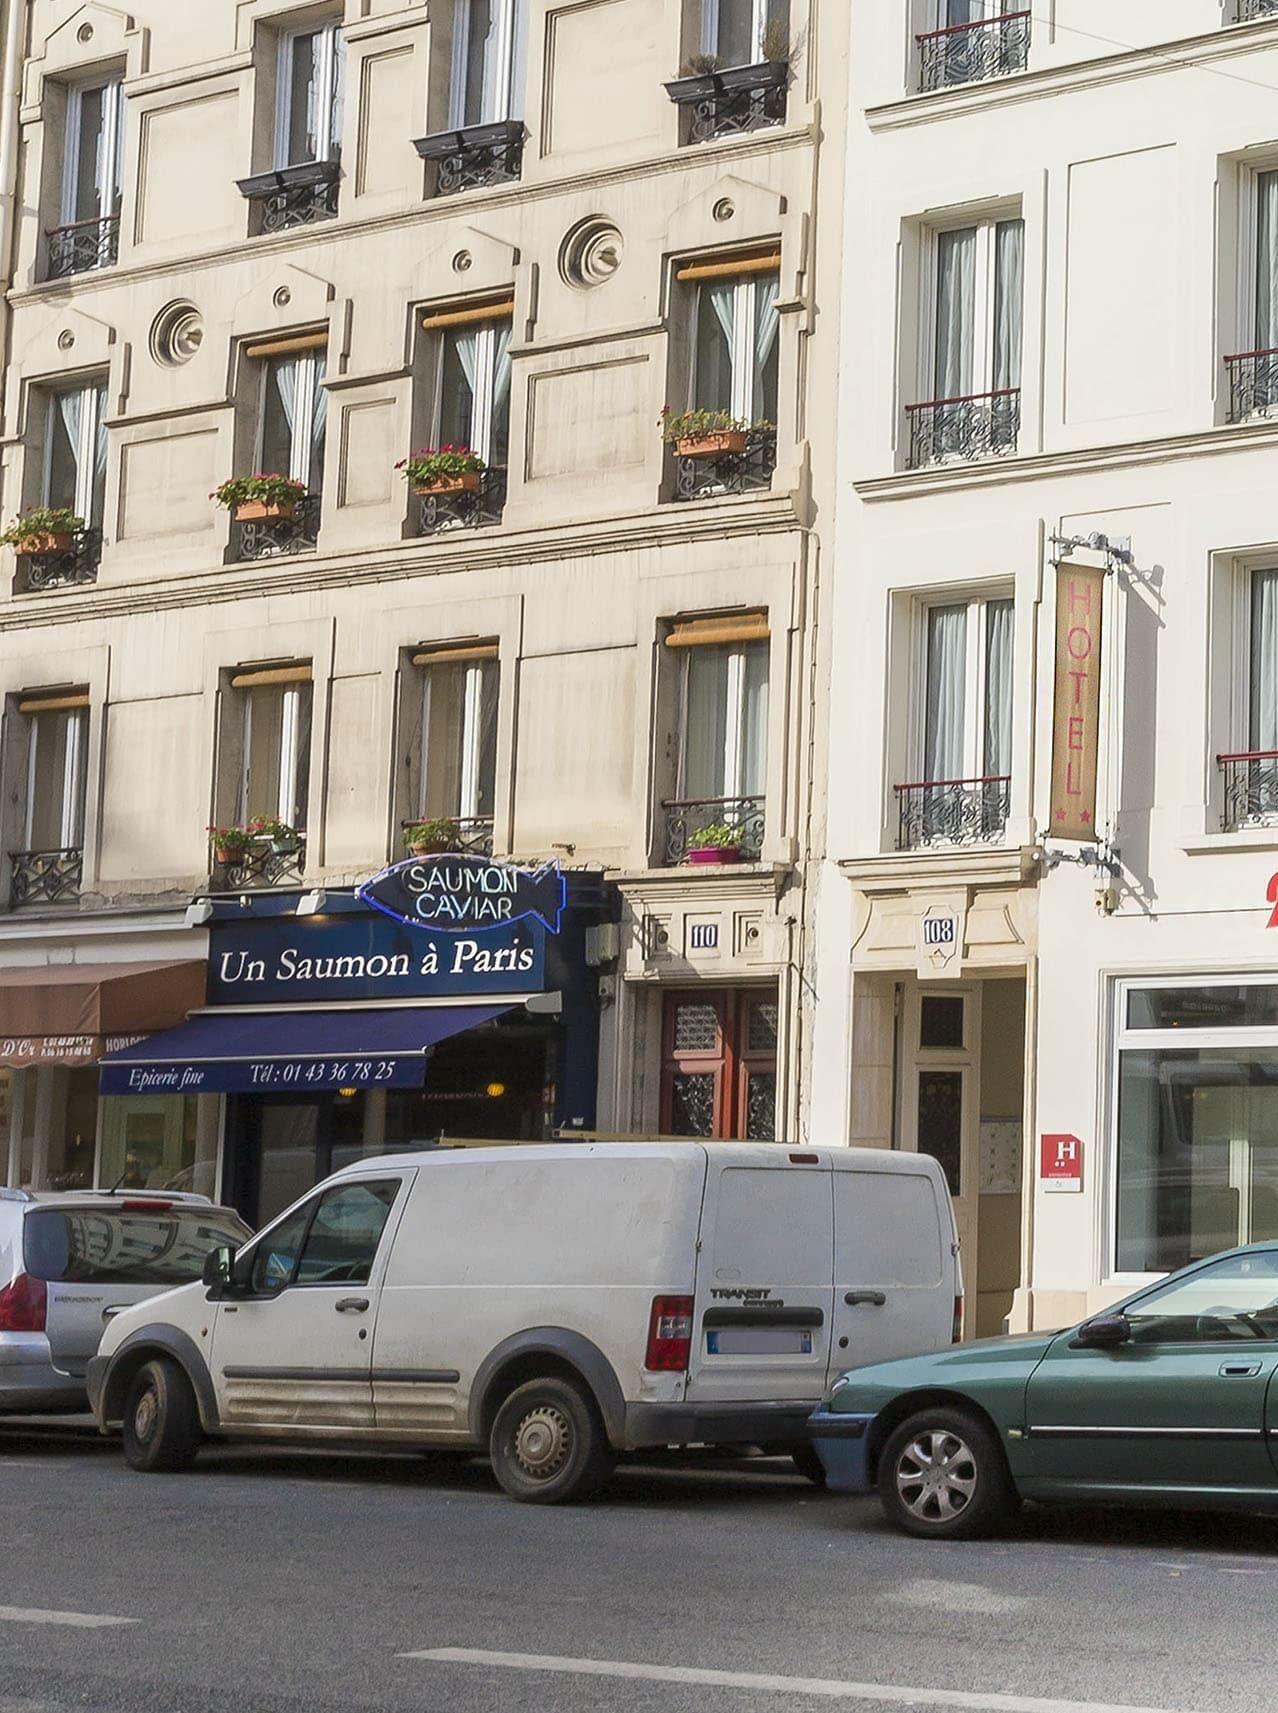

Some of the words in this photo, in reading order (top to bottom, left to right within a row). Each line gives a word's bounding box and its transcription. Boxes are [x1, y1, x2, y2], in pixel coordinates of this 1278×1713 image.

[1066, 581, 1092, 796] HOTEL
[408, 866, 520, 894] SAUMON
[416, 893, 512, 920] CAVIAR
[692, 925, 718, 948] 110
[925, 919, 953, 944] 108
[220, 950, 265, 983] Un
[276, 948, 410, 981] Saumon
[422, 942, 439, 975] à
[450, 938, 535, 974] Paris
[178, 1066, 205, 1090] fine
[283, 1064, 300, 1082] 01
[305, 1063, 324, 1081] 43
[329, 1062, 348, 1081] 36
[350, 1061, 372, 1080] 78
[375, 1061, 397, 1080] 25
[1057, 1141, 1076, 1159] H
